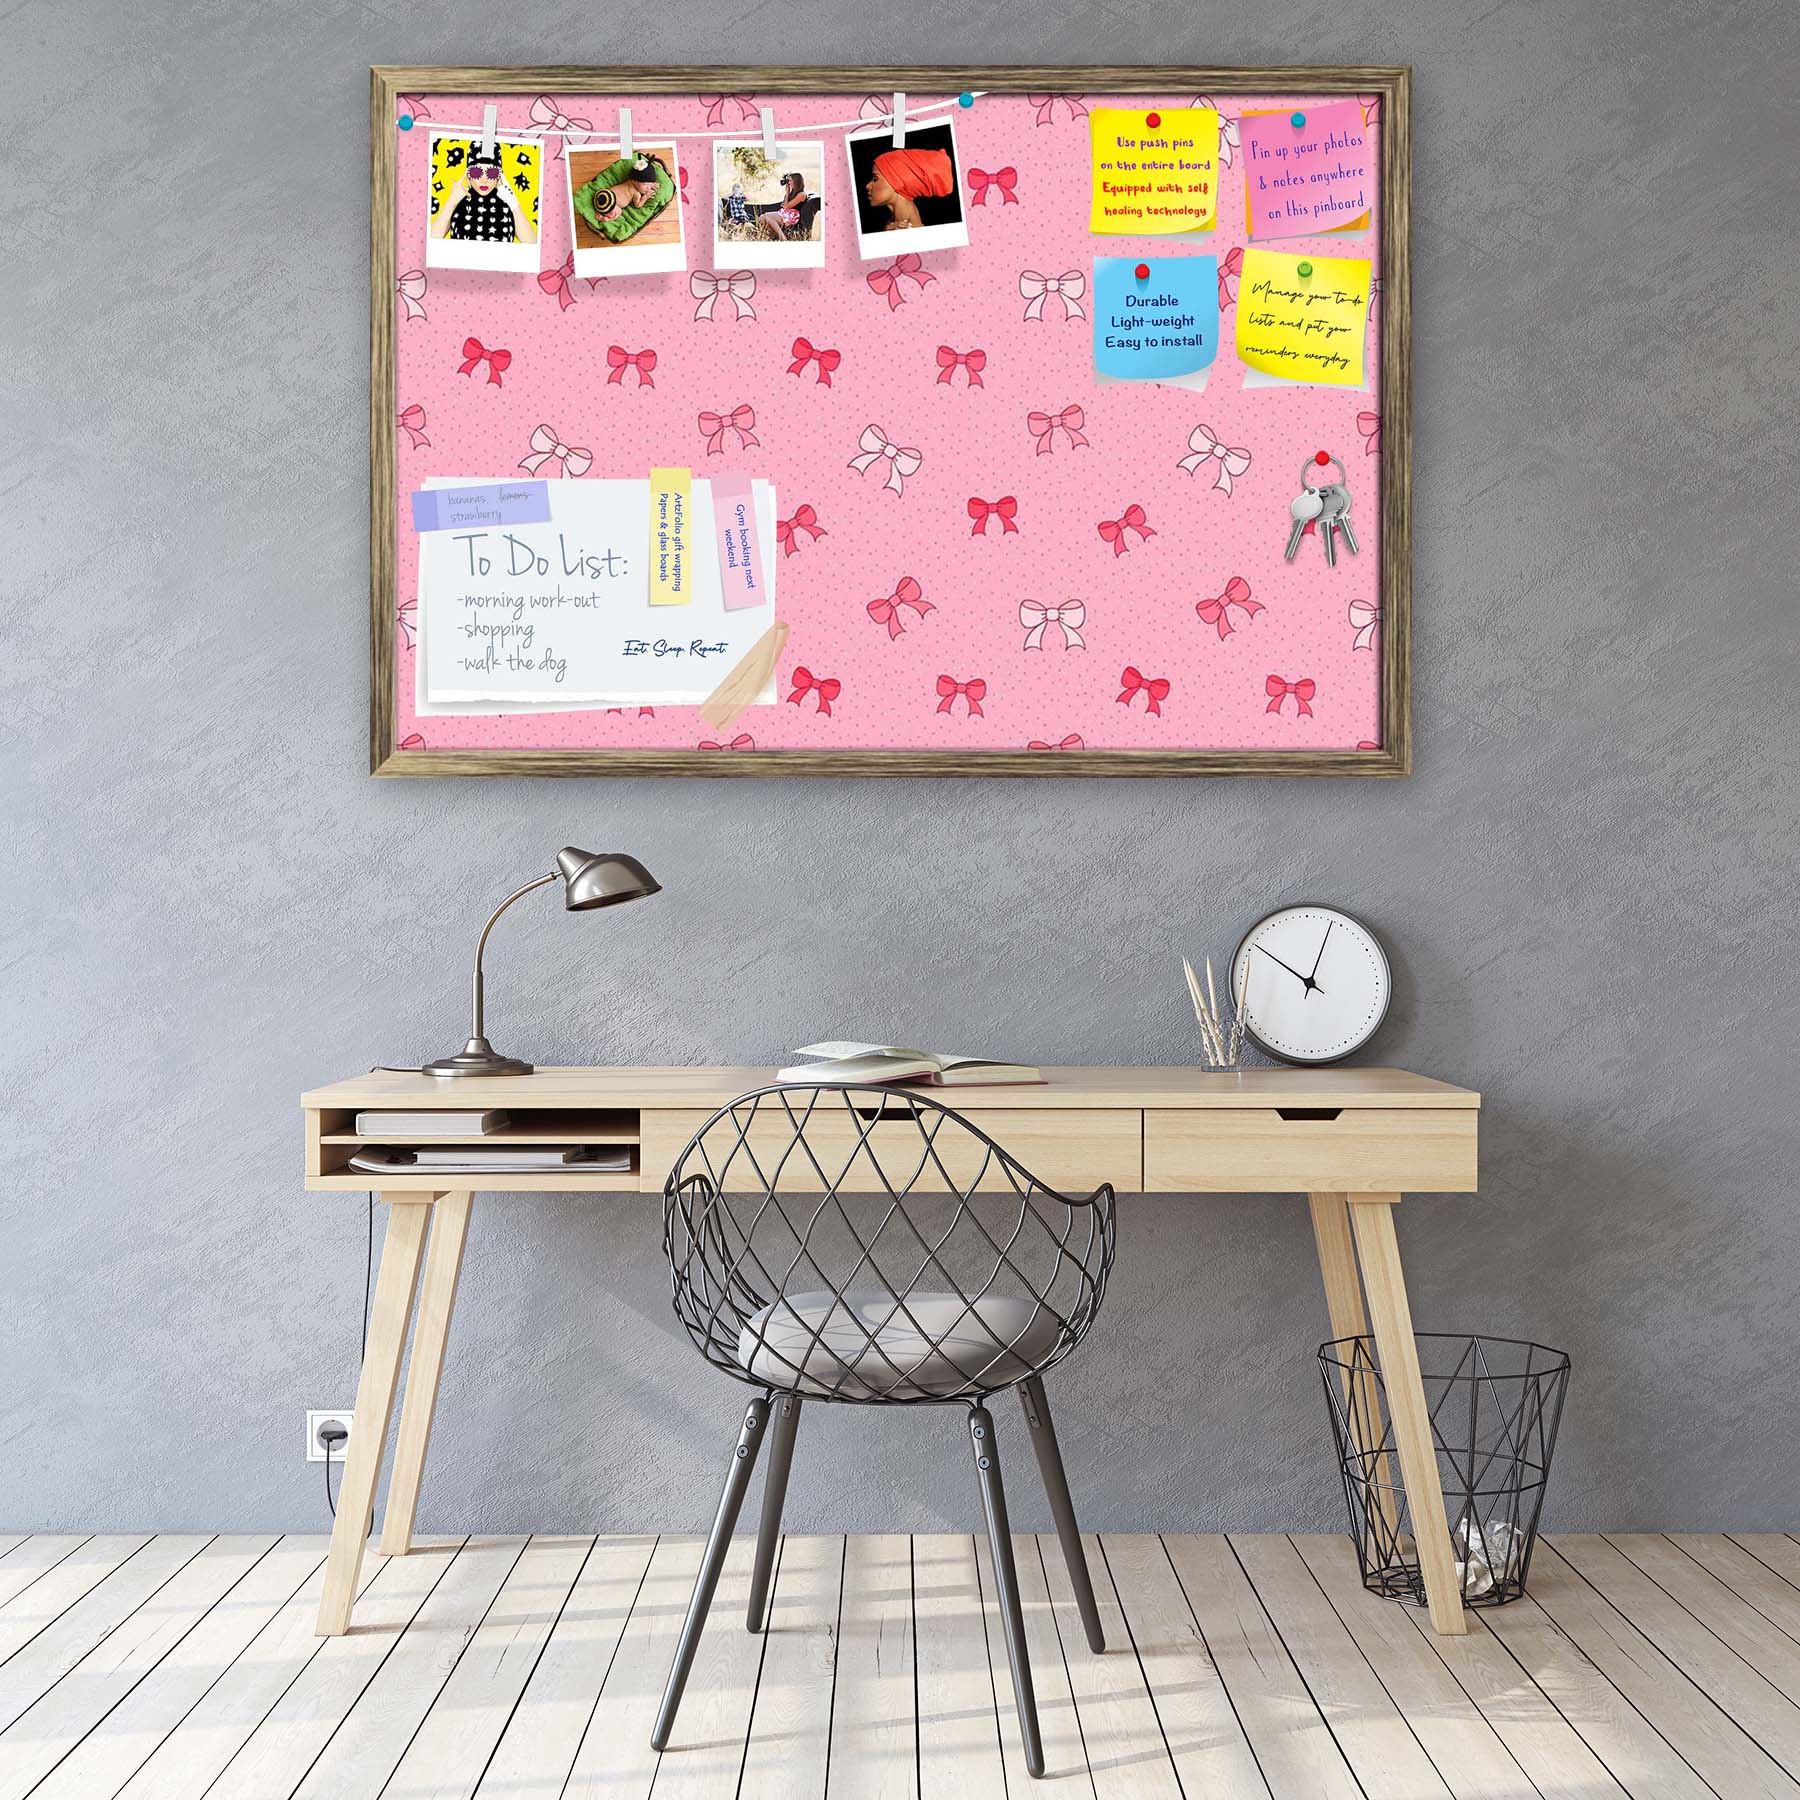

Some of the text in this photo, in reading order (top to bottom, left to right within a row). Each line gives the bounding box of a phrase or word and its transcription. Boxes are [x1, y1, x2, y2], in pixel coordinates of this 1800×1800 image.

[1117, 137, 1194, 151] Use push pins
[1251, 131, 1363, 160] Pin up your photos
[1100, 160, 1211, 171] on the entire board
[1259, 162, 1364, 190] & notes anywhere
[1102, 182, 1208, 196] Equipped with self
[1104, 205, 1207, 218] healing technology
[1268, 190, 1364, 219] on this pinboard
[1126, 294, 1179, 307] Durable
[1252, 280, 1304, 303] Manage
[1308, 293, 1331, 306] your
[1111, 314, 1195, 331] Light-weight
[1279, 318, 1304, 330] and
[1305, 320, 1329, 336] put
[1326, 327, 1352, 338] your
[1105, 334, 1203, 351] Easy to install
[1245, 346, 1351, 370] reminders everyday
[450, 505, 502, 522] strawberry
[658, 493, 669, 520] Papers
[658, 531, 669, 551] glass
[672, 492, 684, 592] ArtzFolio gift wrapping
[725, 528, 738, 568] weekend
[734, 504, 756, 589] Gym booking next
[452, 533, 628, 579] To Do List:
[660, 553, 669, 582] boards
[530, 584, 601, 608] work-out
[506, 645, 535, 670] the
[538, 647, 567, 683] dog
